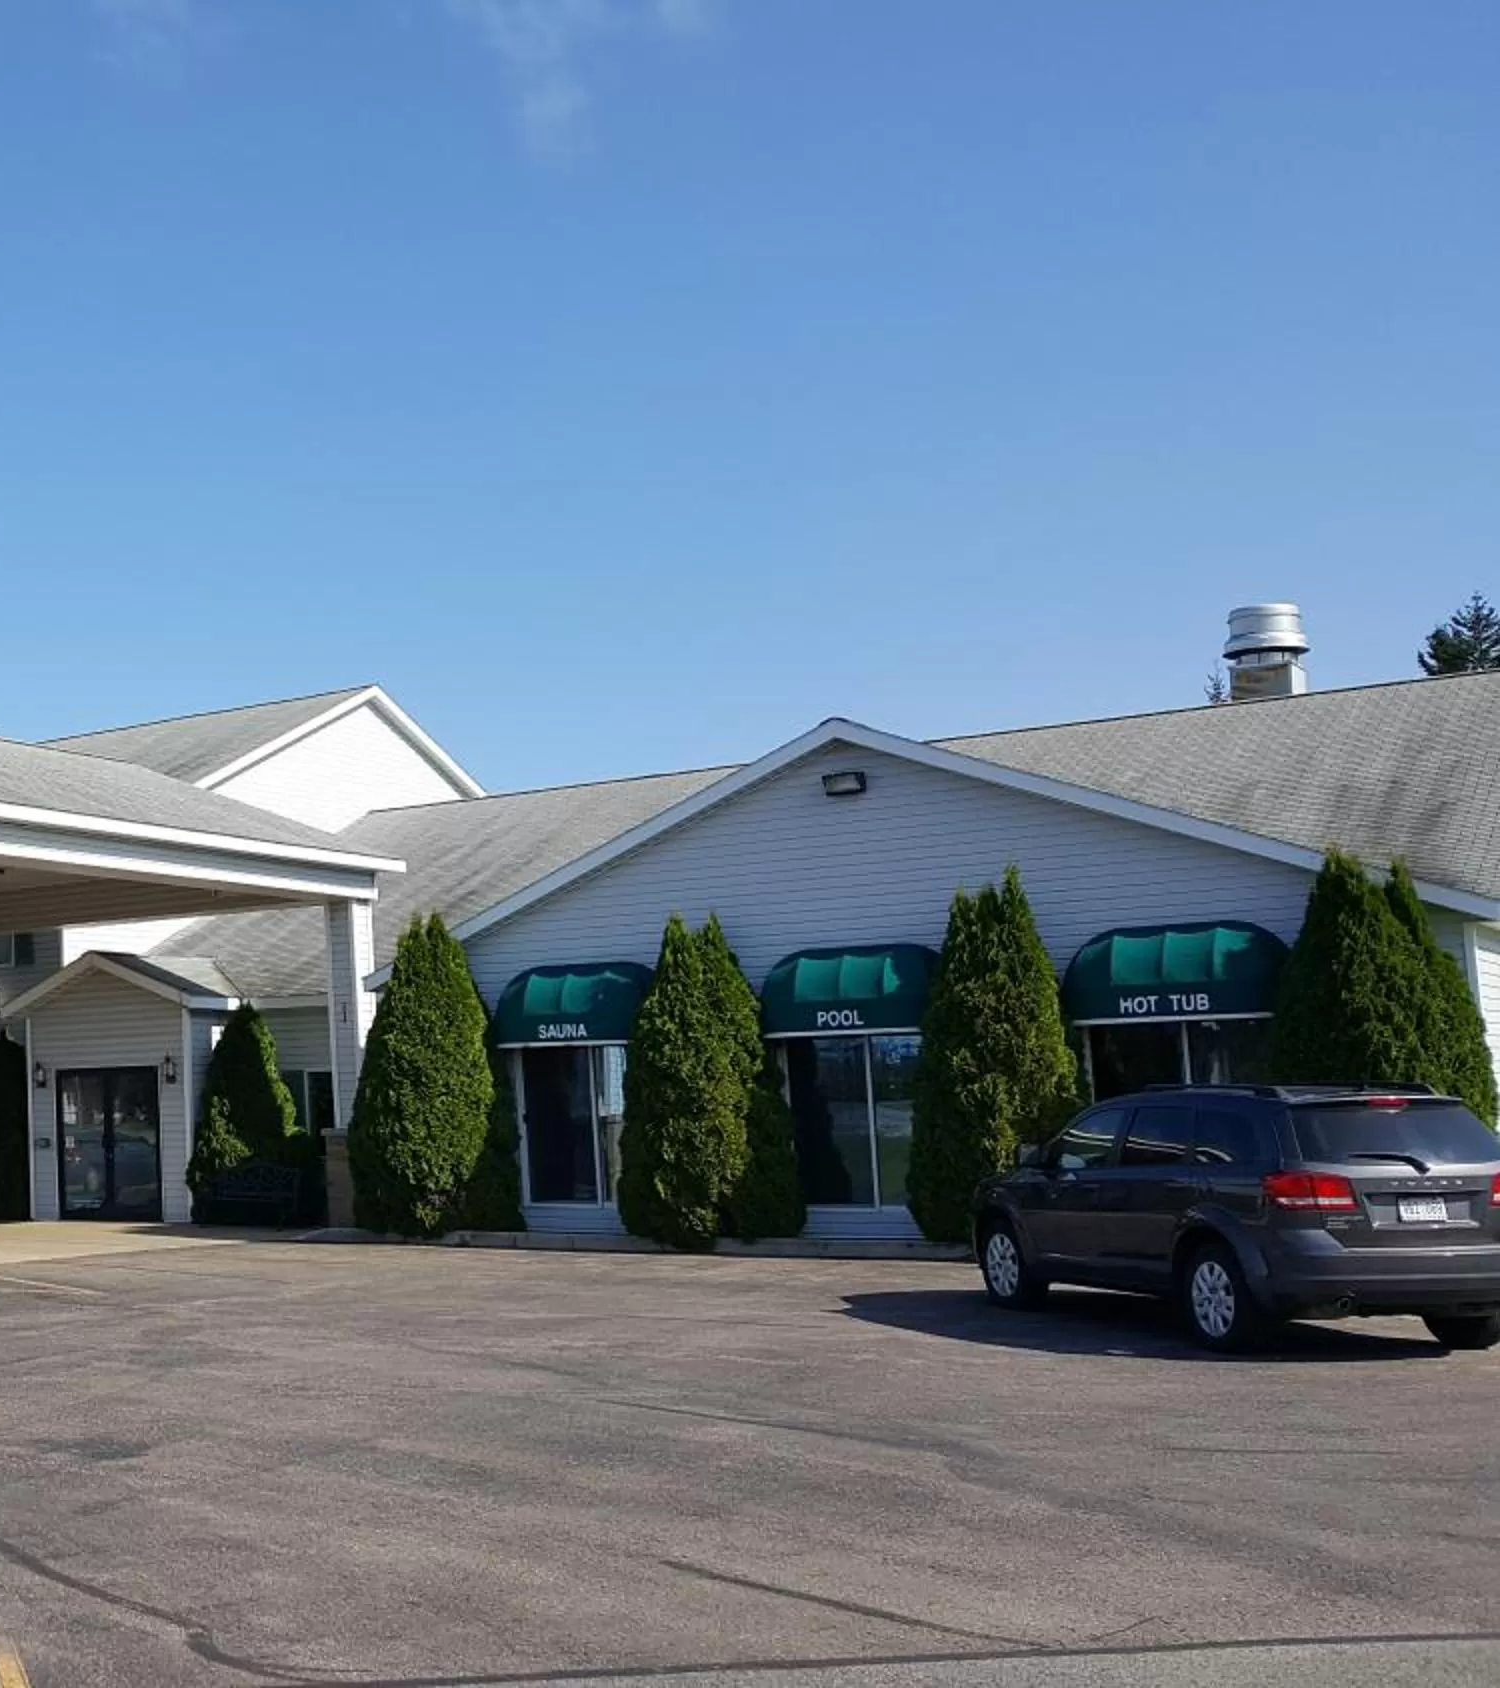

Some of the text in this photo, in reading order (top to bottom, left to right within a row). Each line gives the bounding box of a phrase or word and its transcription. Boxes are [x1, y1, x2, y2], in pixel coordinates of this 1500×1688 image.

[1119, 993, 1210, 1014] HOT TUB
[817, 1009, 864, 1027] POOL
[538, 1023, 588, 1039] SAUNA
